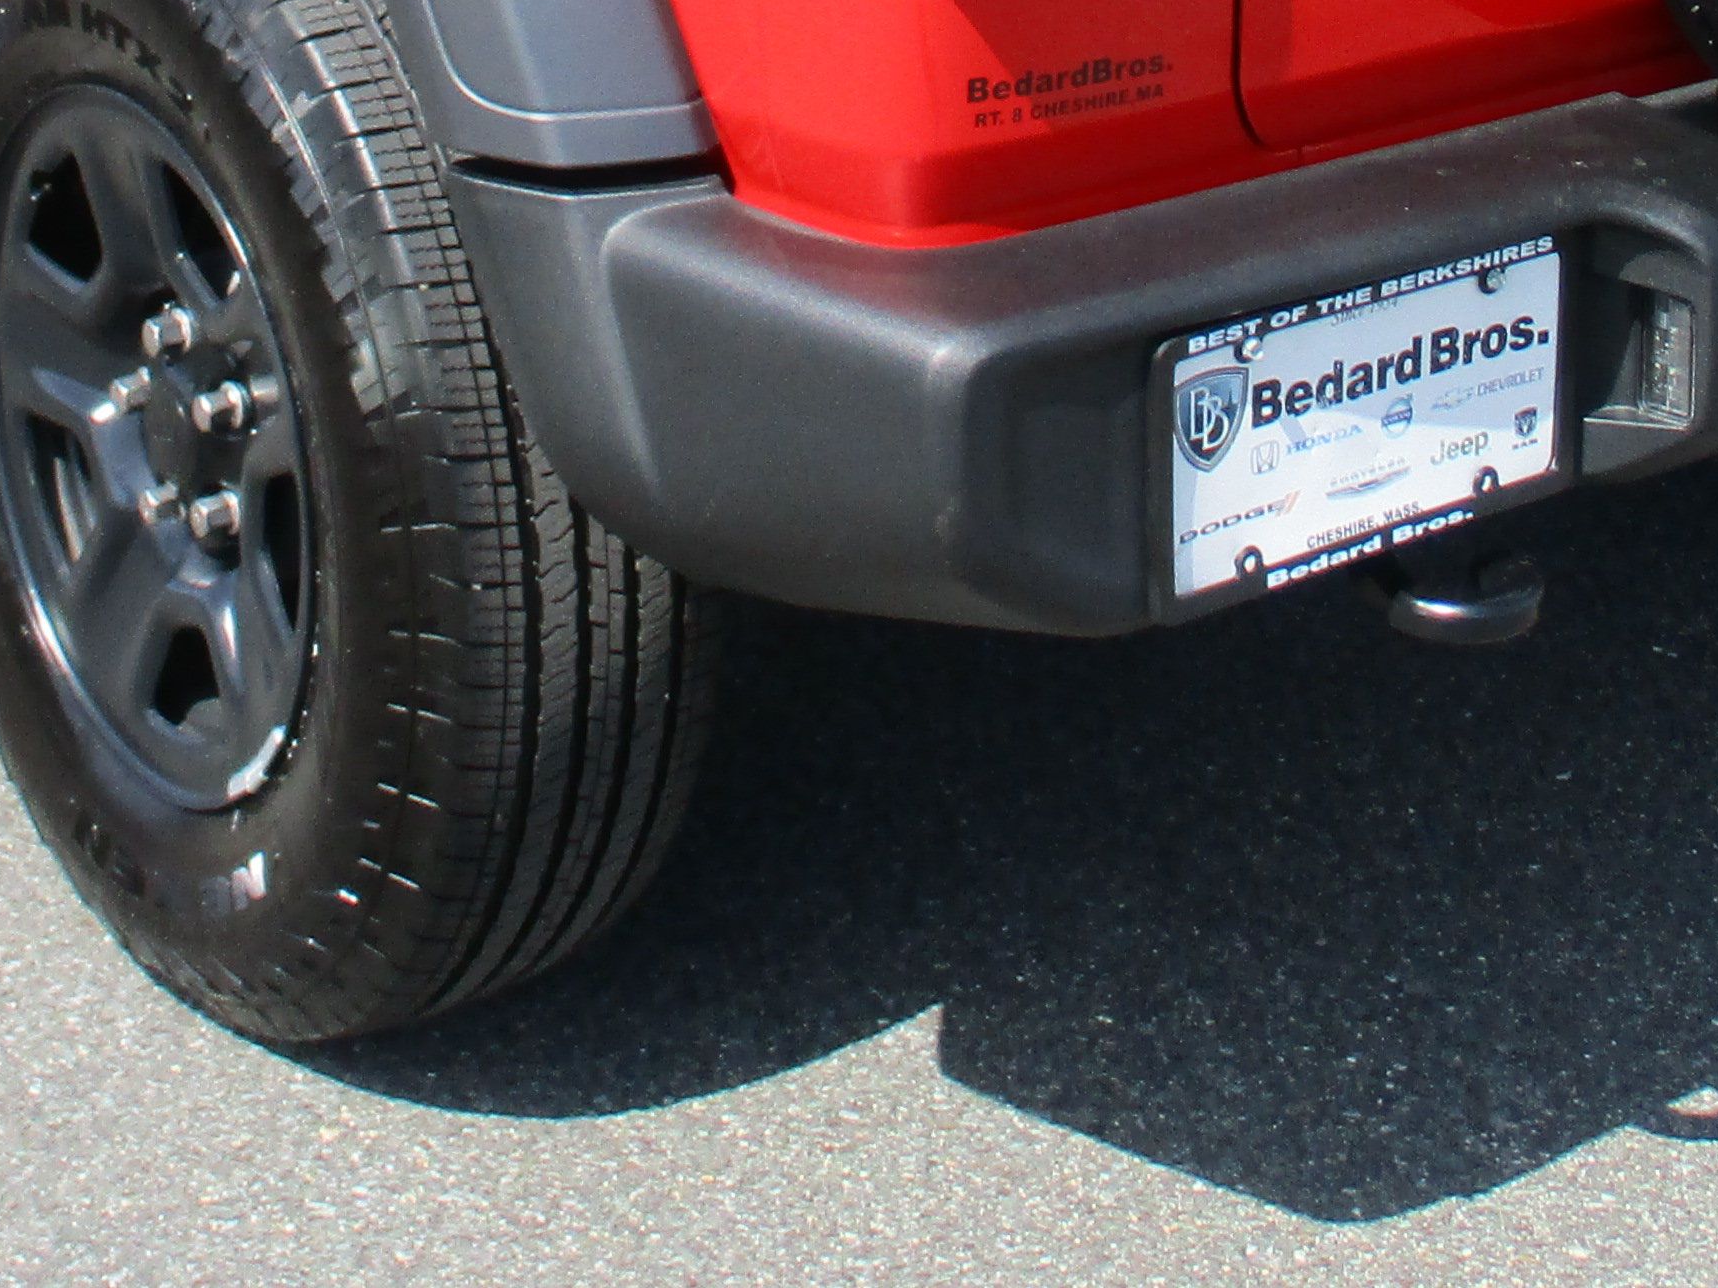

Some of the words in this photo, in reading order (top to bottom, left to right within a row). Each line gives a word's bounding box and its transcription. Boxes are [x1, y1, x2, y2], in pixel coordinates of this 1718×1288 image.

[1189, 317, 1263, 355] BEST
[1270, 304, 1308, 328] OF
[1316, 286, 1373, 314] THE
[1380, 235, 1554, 298] BERKSHIRES
[1285, 424, 1363, 457] HONDA
[1430, 431, 1489, 466] Jeep
[1383, 499, 1423, 524] MASS.
[1266, 532, 1383, 591] Bedard
[1392, 505, 1474, 546] Bros.
